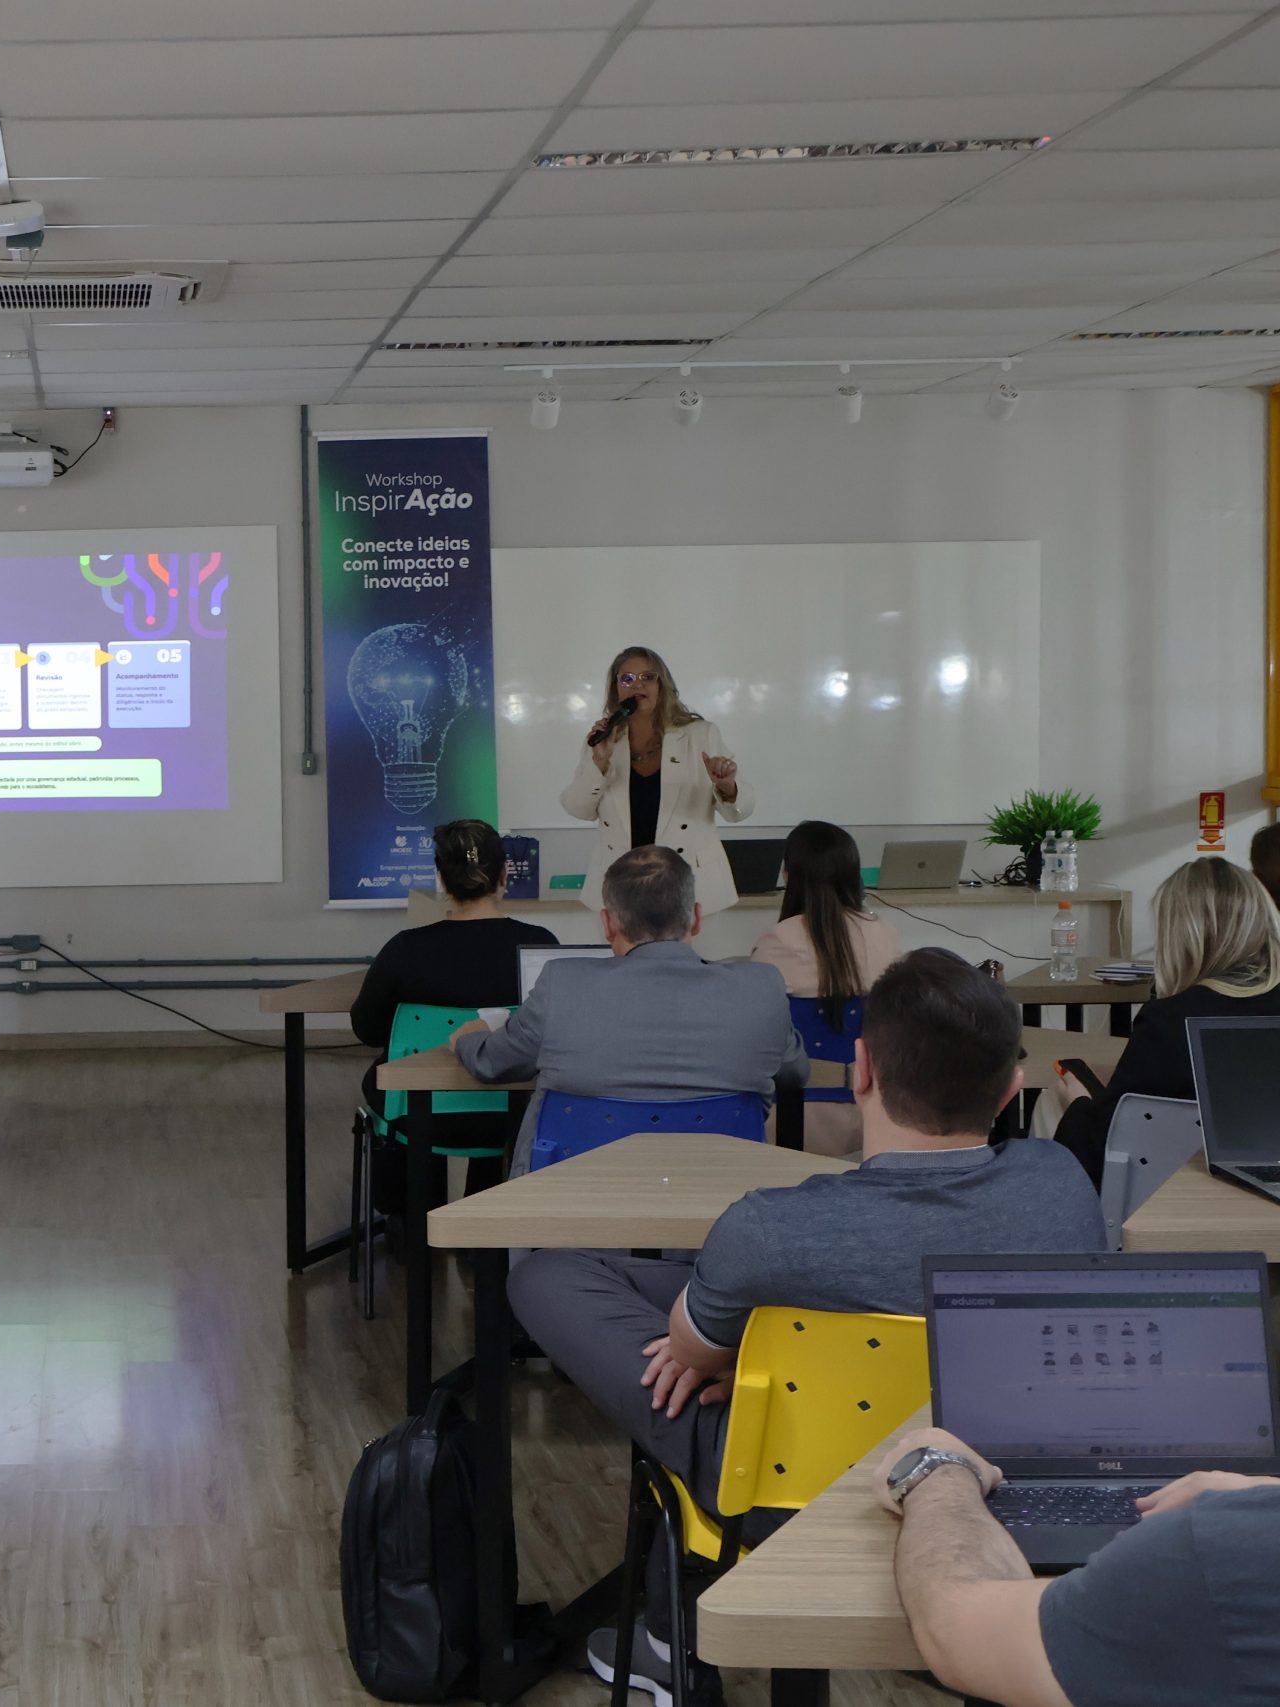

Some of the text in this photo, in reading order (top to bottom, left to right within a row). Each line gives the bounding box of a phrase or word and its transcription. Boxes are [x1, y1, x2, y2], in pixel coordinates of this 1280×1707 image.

[365, 471, 443, 488] Workshop
[334, 488, 474, 517] InspirAção
[341, 536, 470, 554] Conecte ideias
[342, 555, 470, 575] com impacto e
[364, 572, 449, 592] inovação!
[156, 648, 182, 663] 05
[951, 1296, 996, 1306] educare
[1098, 1462, 1124, 1470] DELL
